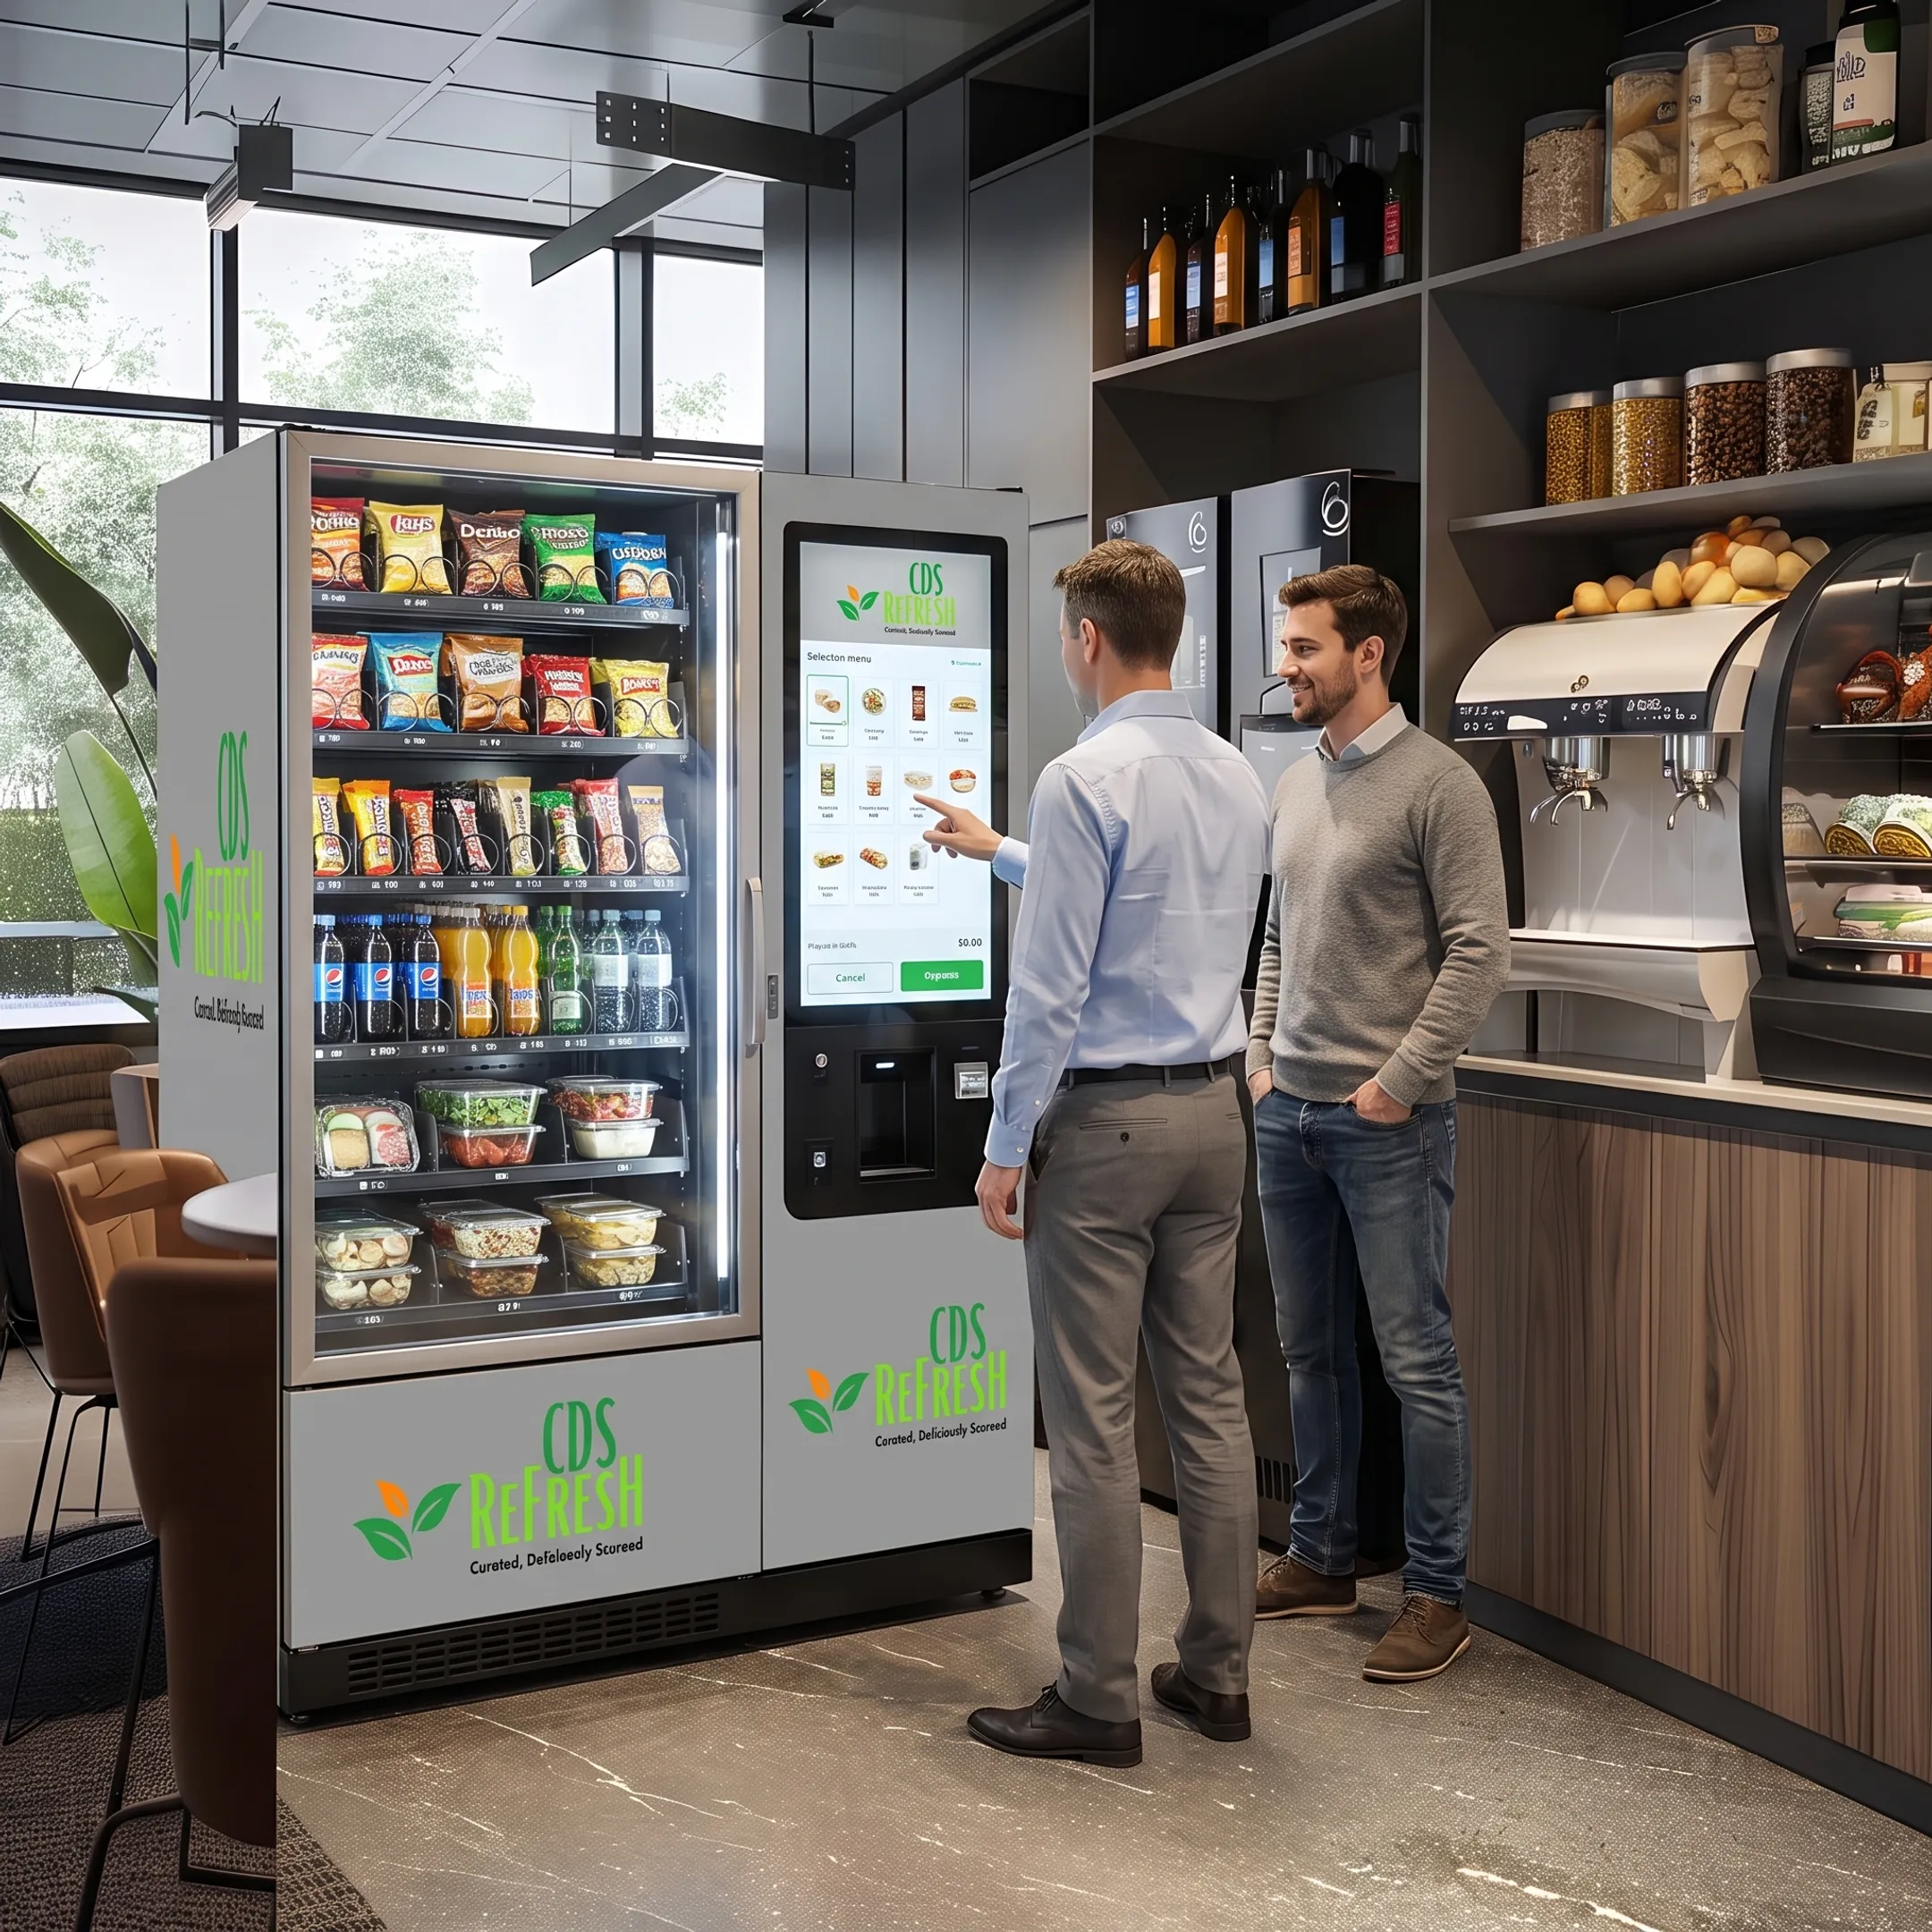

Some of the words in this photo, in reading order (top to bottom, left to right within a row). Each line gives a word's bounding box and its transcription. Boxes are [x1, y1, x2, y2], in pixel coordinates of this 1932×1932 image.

[909, 562, 944, 596] CDS
[807, 652, 845, 662] Selecton
[848, 655, 871, 663] menu
[217, 731, 250, 861] CDS
[835, 973, 866, 982] Cancel
[929, 1302, 987, 1365] CDS
[543, 1397, 617, 1475] CDS
[919, 1423, 968, 1441] Deliciously
[970, 1417, 1007, 1435] Scoreed
